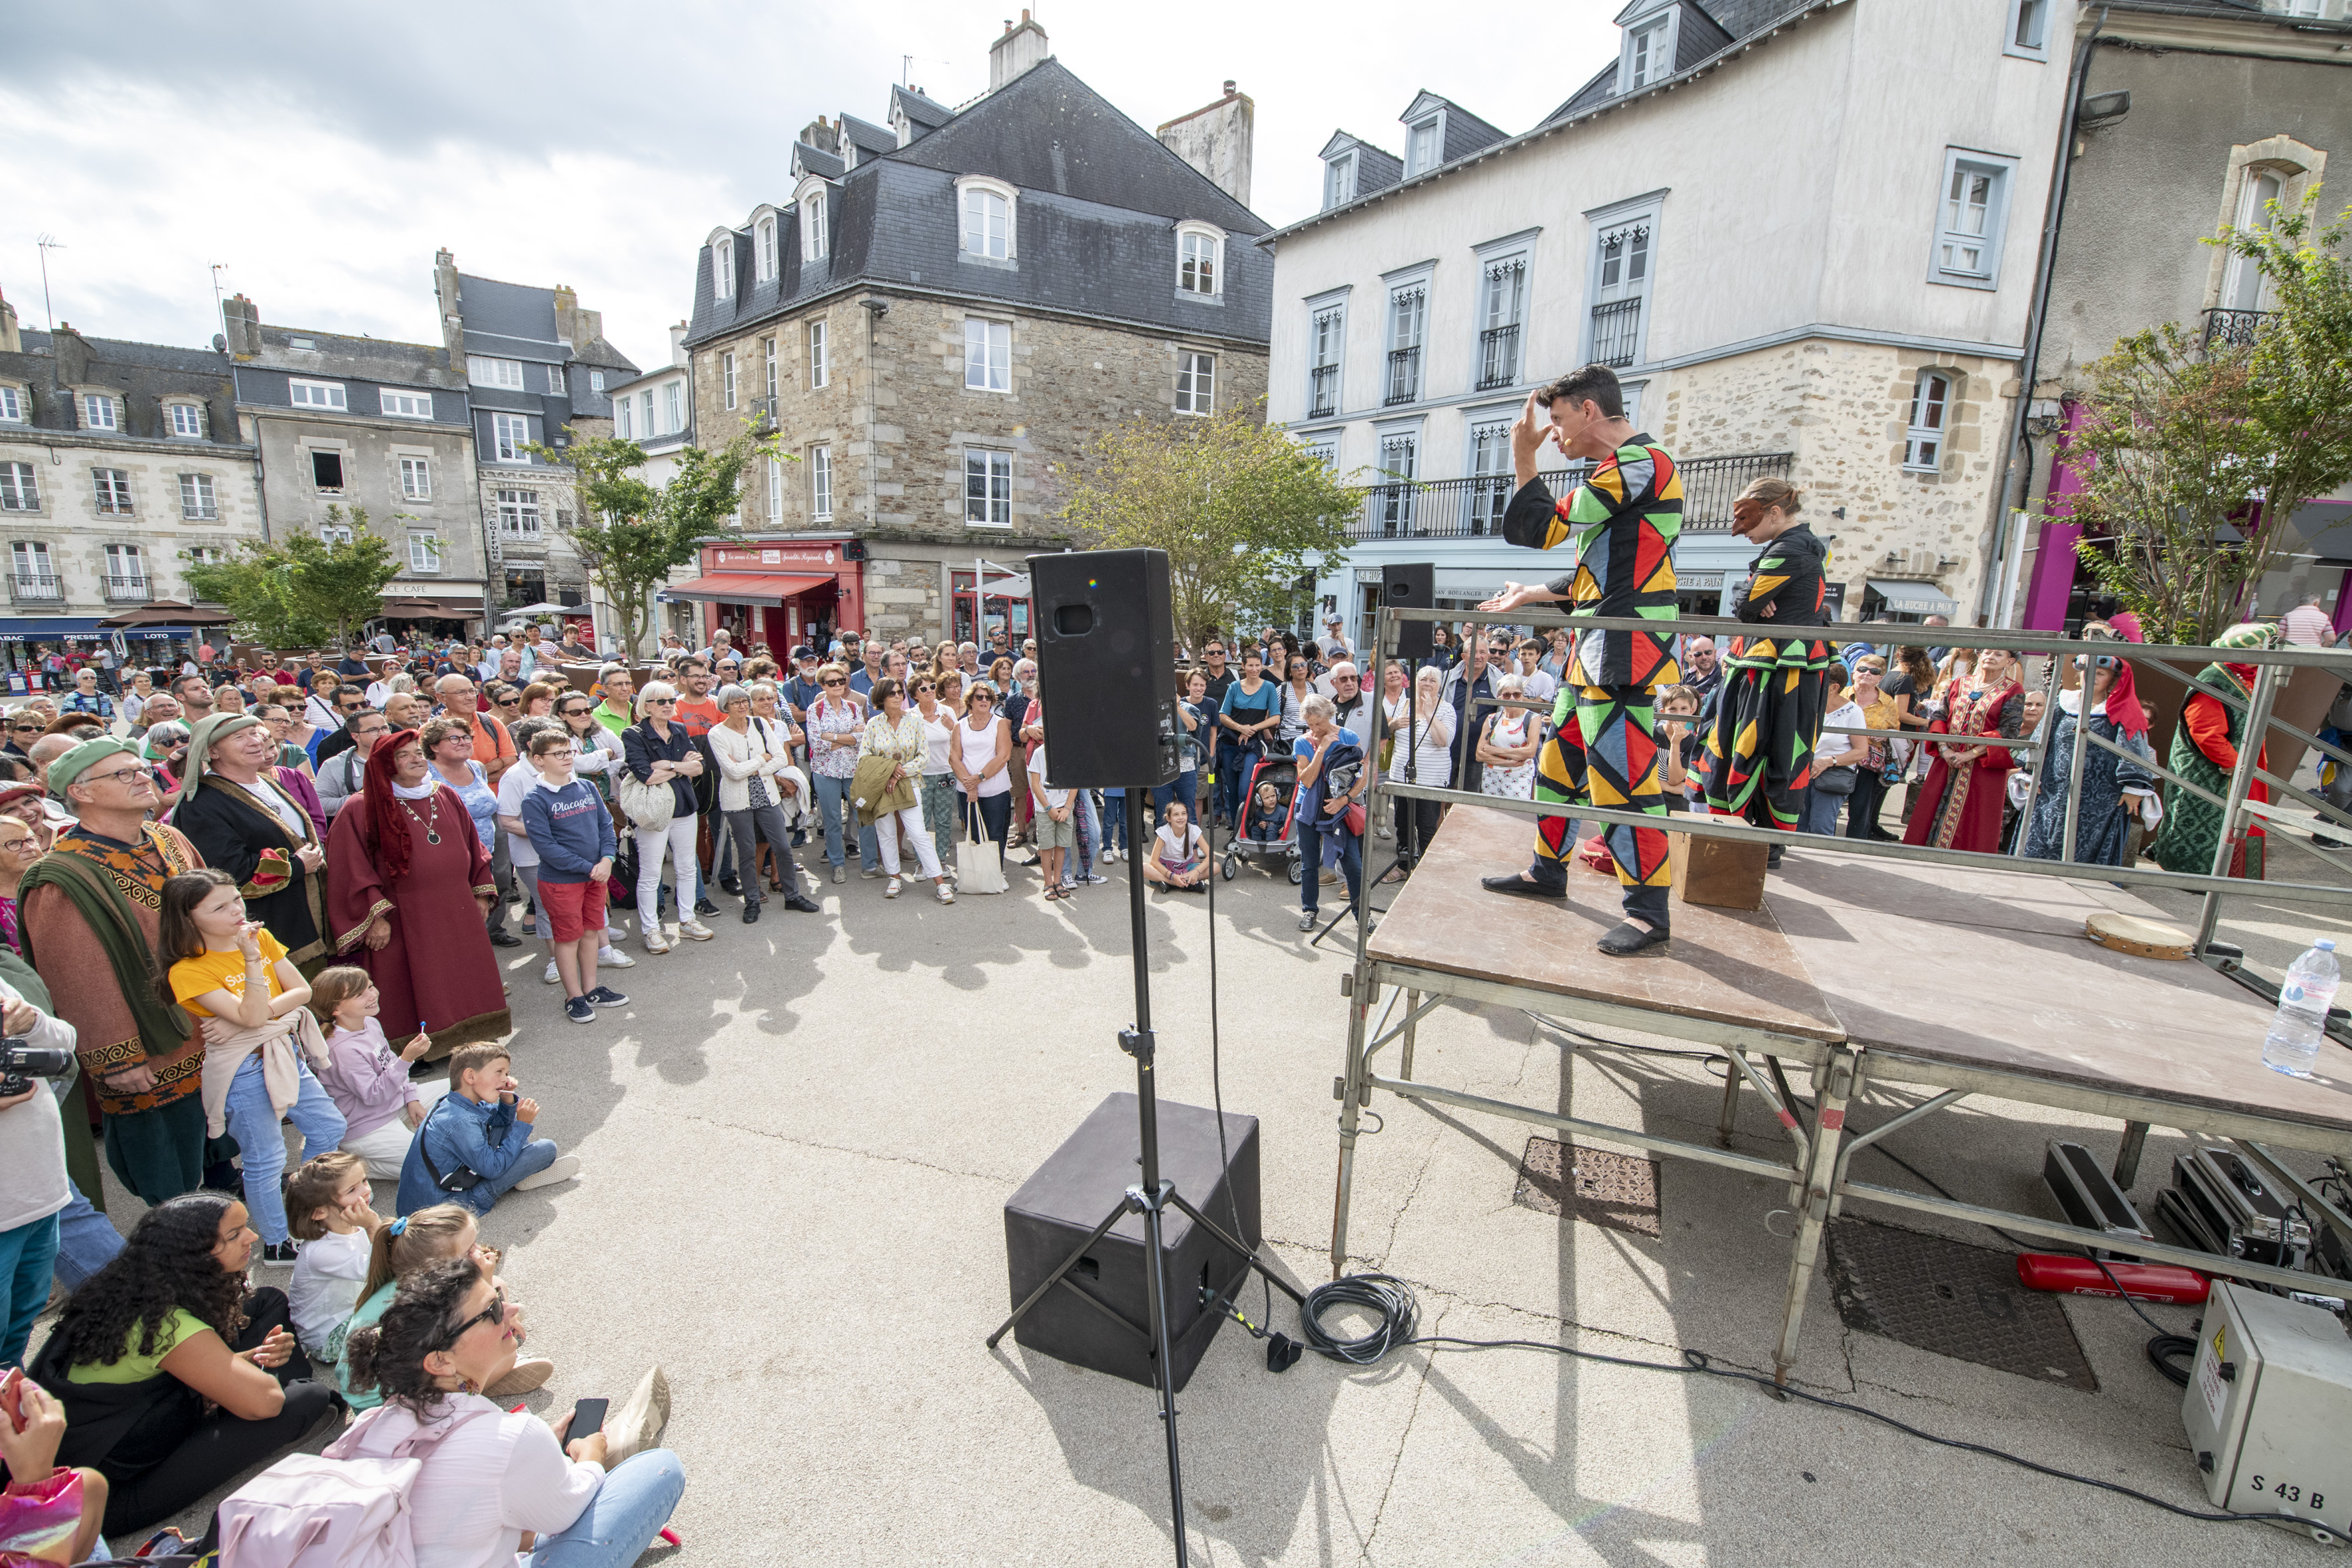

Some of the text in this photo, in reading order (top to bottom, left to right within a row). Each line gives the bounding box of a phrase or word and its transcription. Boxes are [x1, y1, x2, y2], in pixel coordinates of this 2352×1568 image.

[489, 520, 499, 560] COIFFURE
[1358, 571, 1366, 581] LA
[404, 584, 427, 593] CAFÉ
[1894, 599, 1903, 610] LA
[1905, 600, 1928, 611] HUCHE
[1929, 602, 1935, 613] A
[552, 797, 589, 815] Placage
[2251, 1475, 2324, 1510] S 43 B
